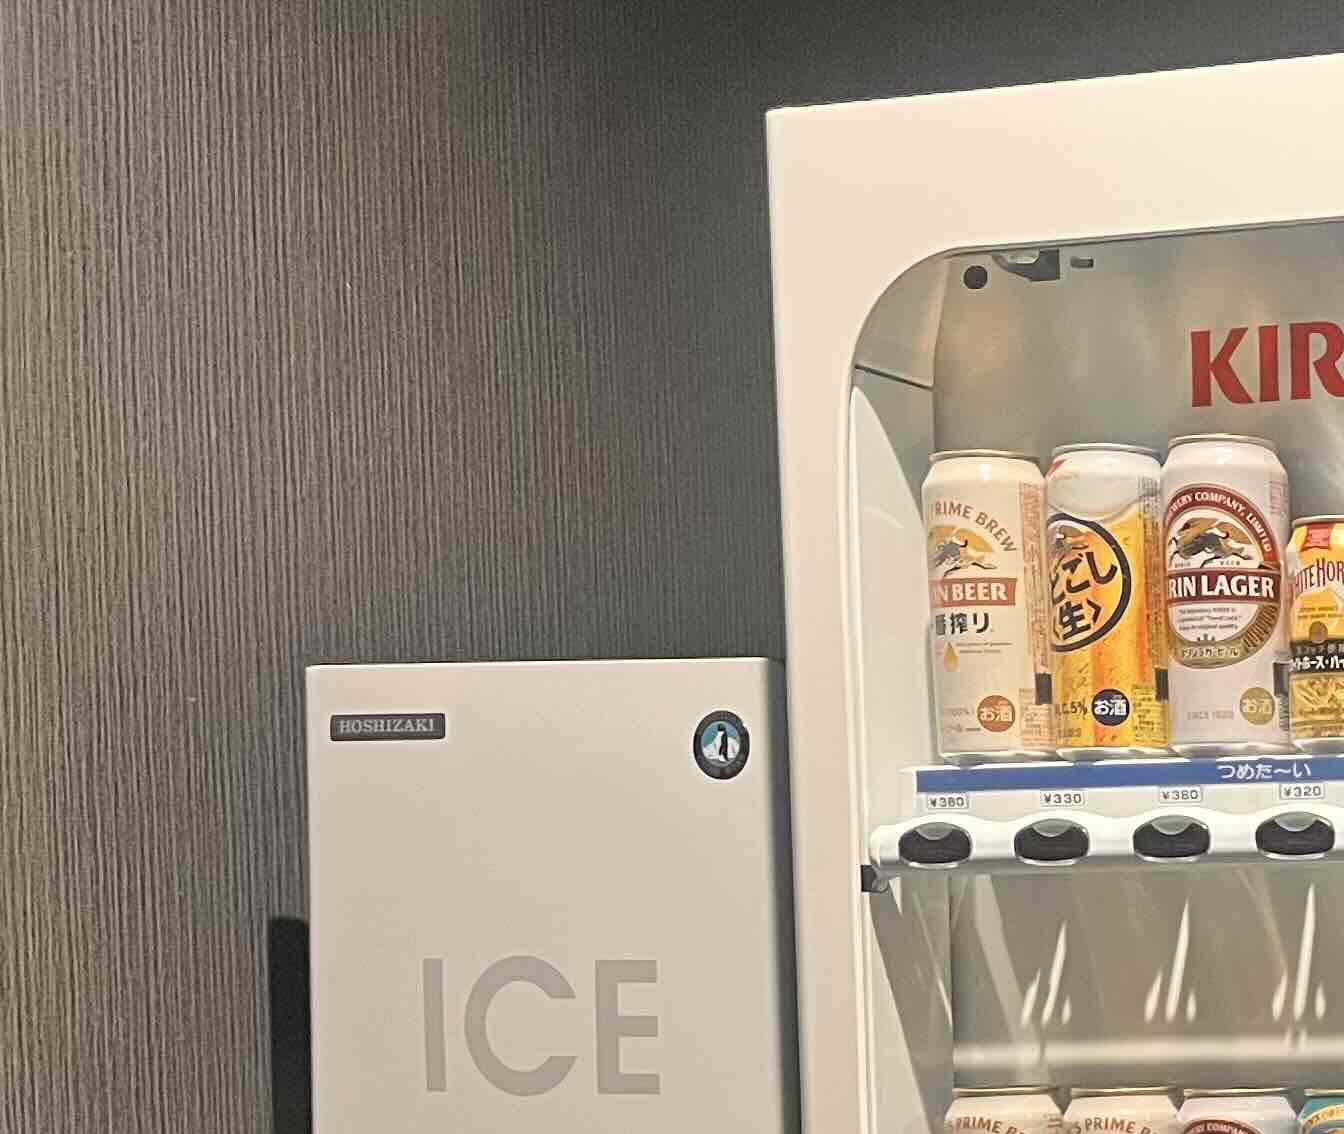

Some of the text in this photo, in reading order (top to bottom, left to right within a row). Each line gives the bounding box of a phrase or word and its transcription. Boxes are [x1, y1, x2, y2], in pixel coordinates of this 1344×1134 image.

[930, 500, 1017, 552] RIME BREW
[951, 582, 1008, 602] BEER
[1168, 574, 1275, 599] RIN LAGER
[980, 702, 1013, 721] お酒
[1094, 699, 1127, 716] お酒
[340, 719, 434, 733] HOSHIZAKI
[1044, 793, 1082, 804] ¥330
[1283, 785, 1321, 797] ¥320
[423, 955, 661, 1097] ICE
[1085, 1117, 1136, 1134] PRIME
